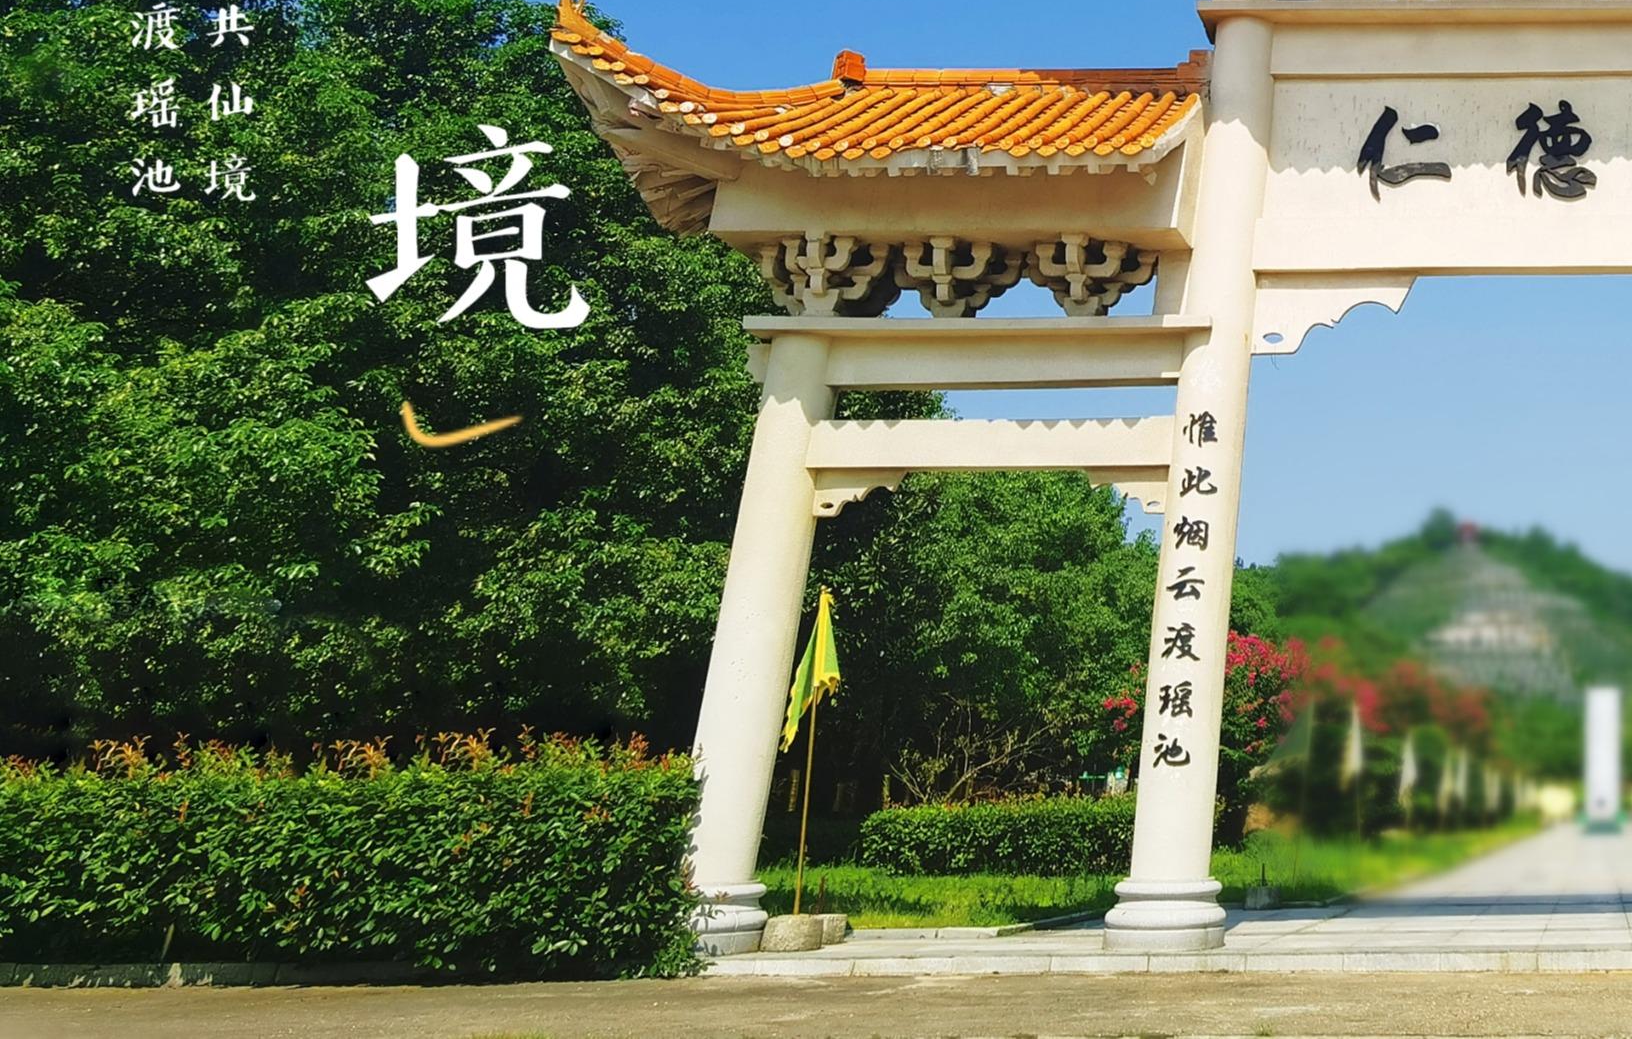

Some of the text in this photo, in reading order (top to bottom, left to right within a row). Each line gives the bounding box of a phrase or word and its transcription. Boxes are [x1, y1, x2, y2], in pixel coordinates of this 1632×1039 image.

[1151, 410, 1219, 770] 惟此烟云渡瑶池
